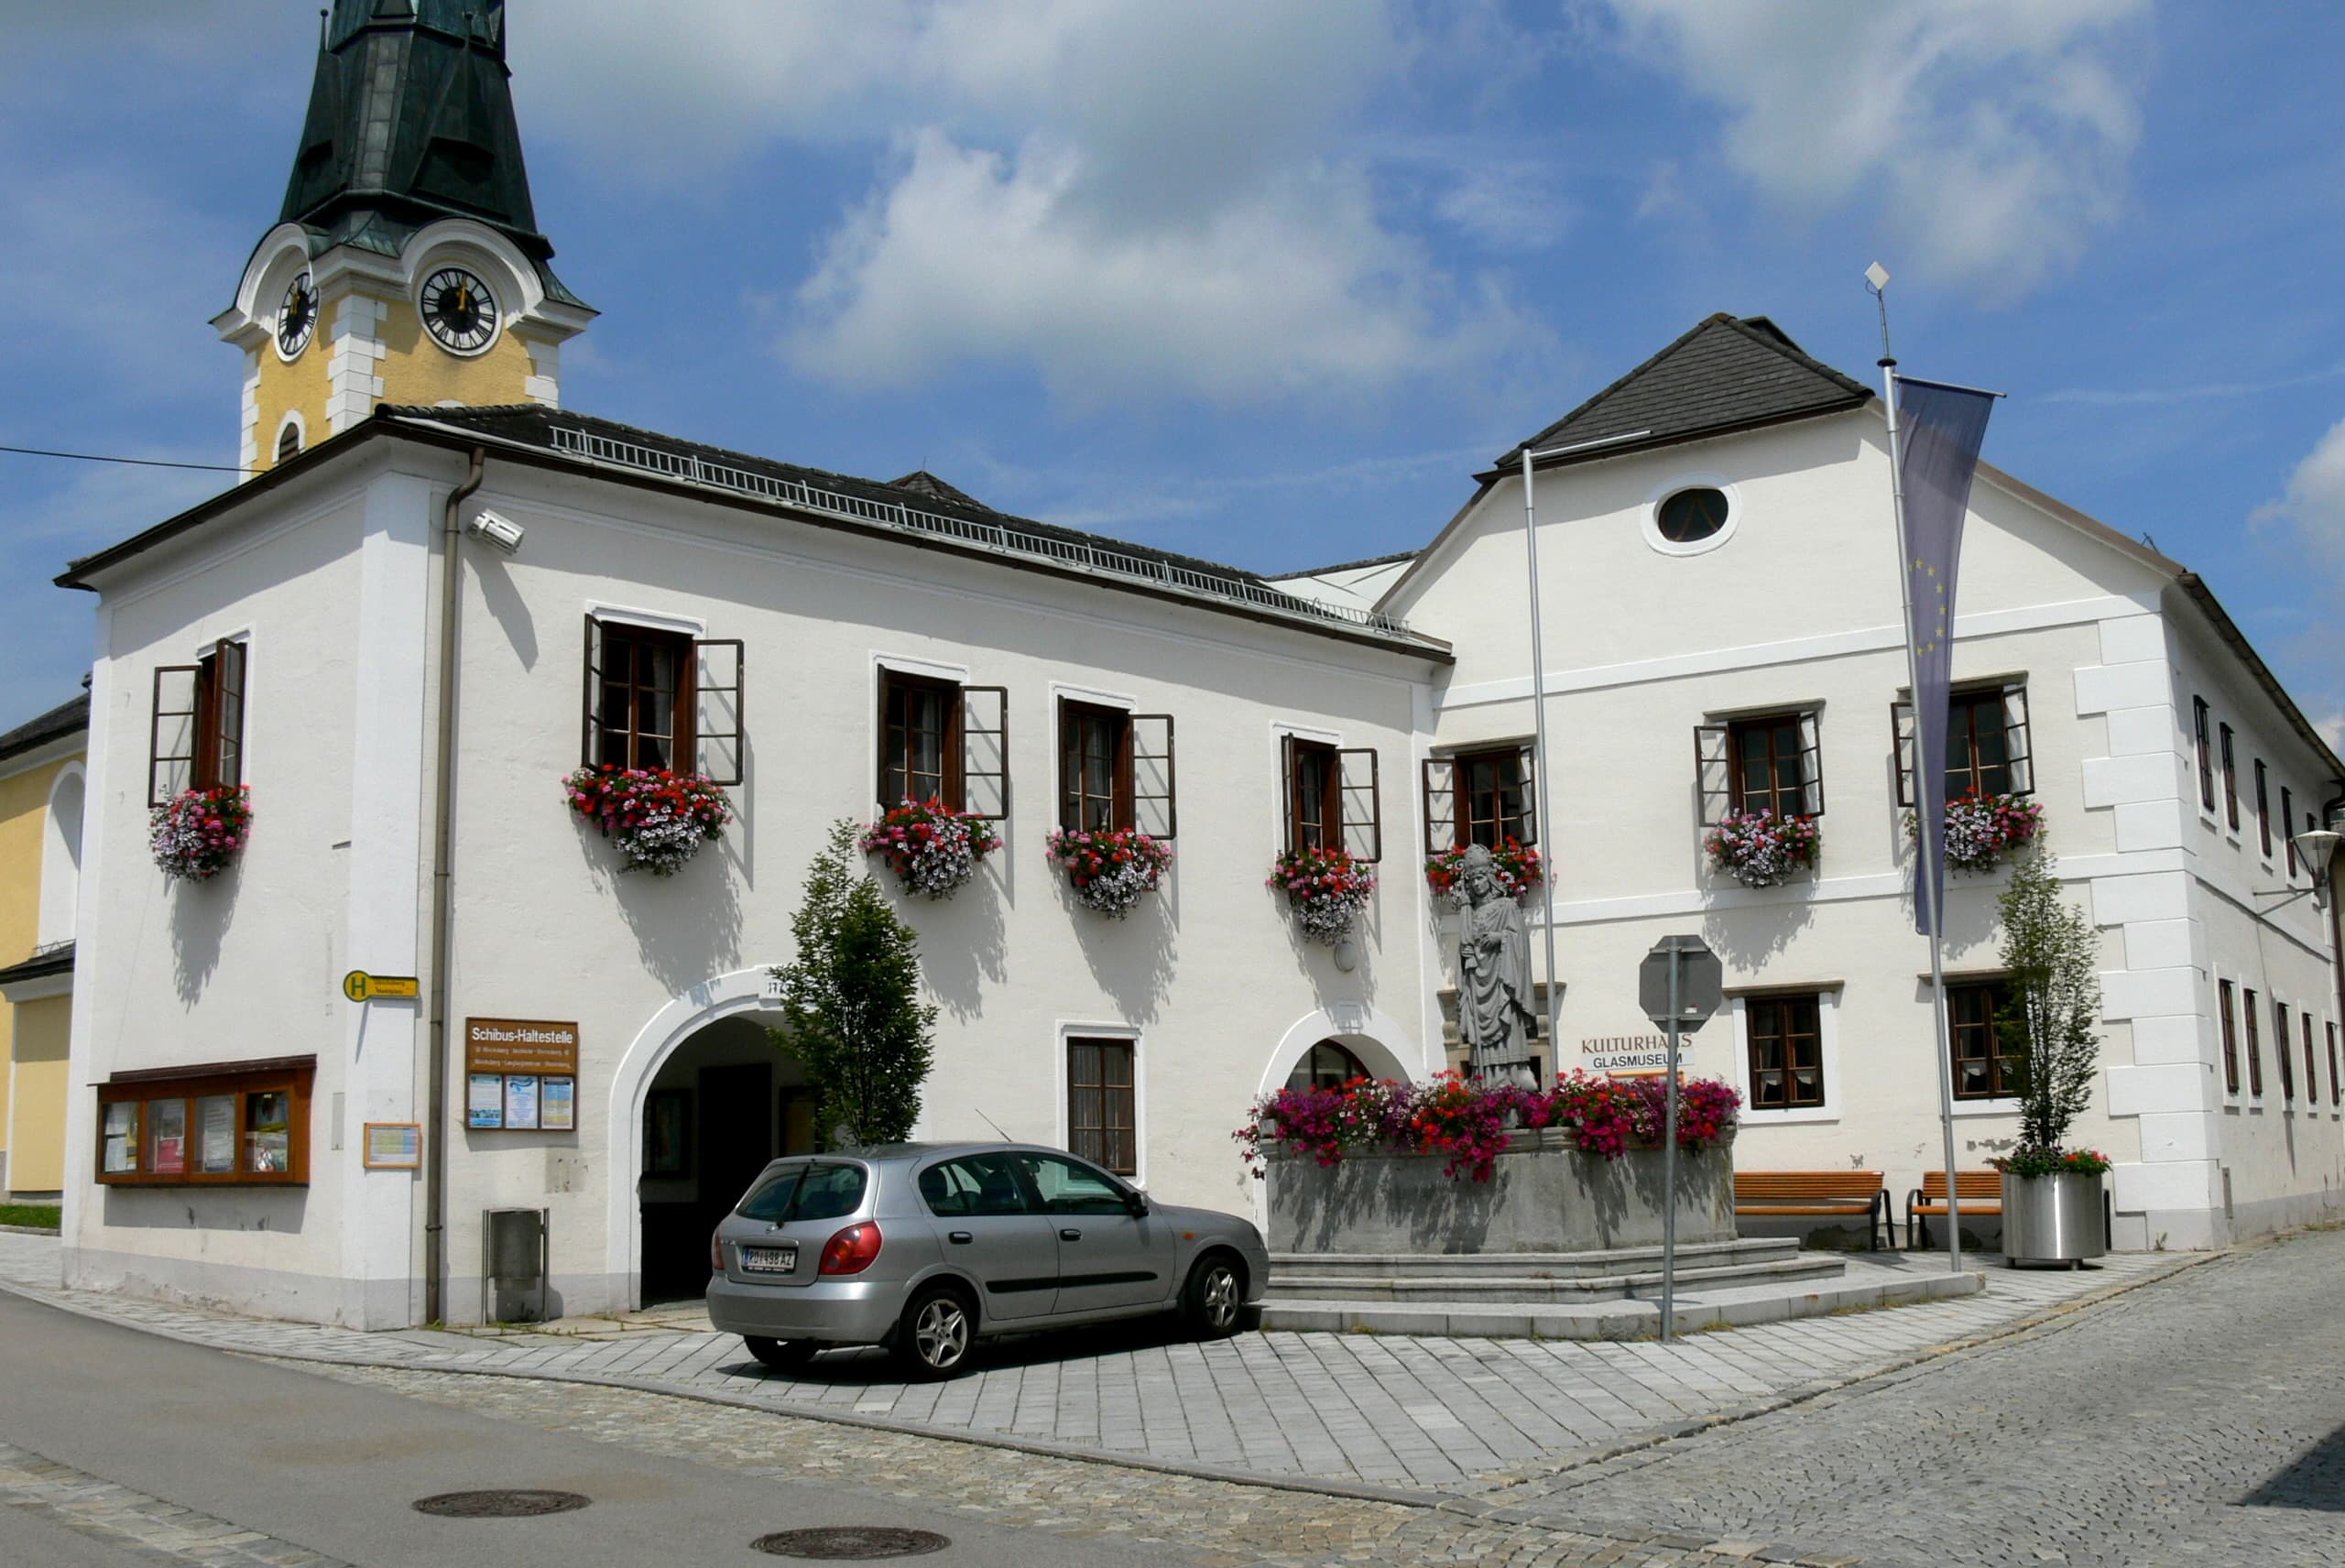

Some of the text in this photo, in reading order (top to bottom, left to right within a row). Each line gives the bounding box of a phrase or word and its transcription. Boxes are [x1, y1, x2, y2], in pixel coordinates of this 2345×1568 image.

[352, 977, 365, 996] H
[472, 1027, 573, 1043] Schibus-Haltestelle
[1582, 1033, 1692, 1054] KULTURHAS
